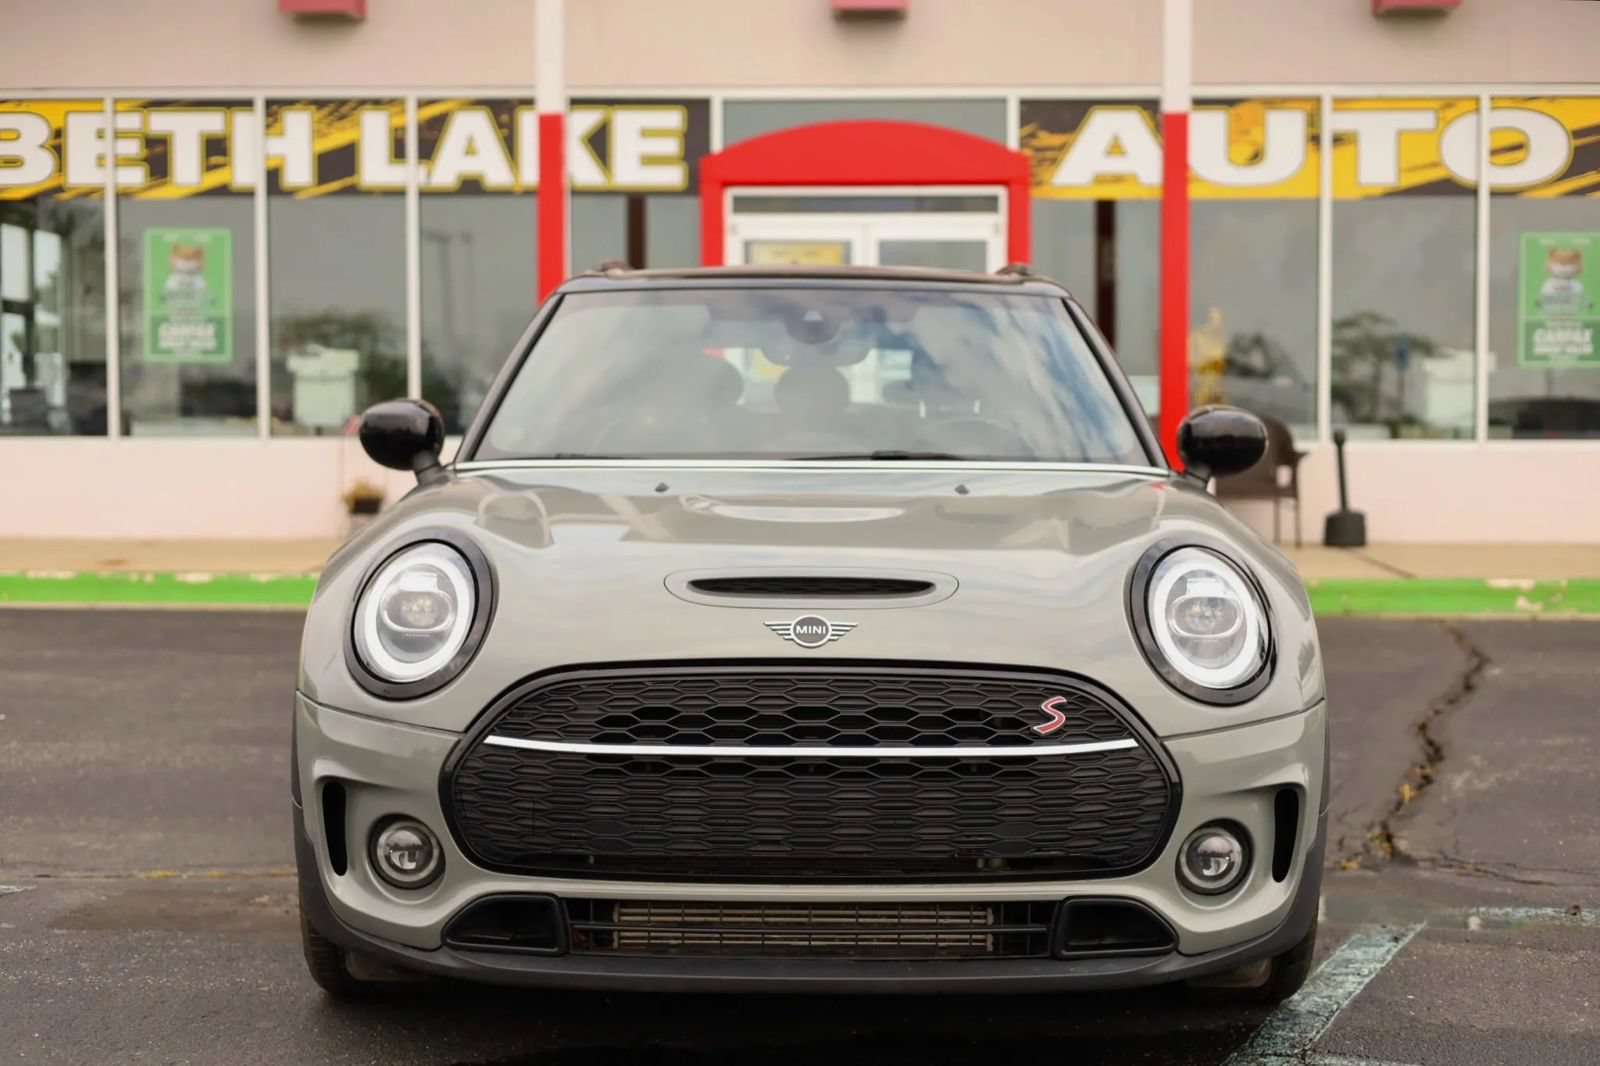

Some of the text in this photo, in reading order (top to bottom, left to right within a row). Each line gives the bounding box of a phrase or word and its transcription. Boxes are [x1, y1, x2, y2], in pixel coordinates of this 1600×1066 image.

[0, 106, 1573, 191] BETH LAKE AUTO
[796, 625, 826, 635] MINI
[1032, 695, 1067, 734] S
